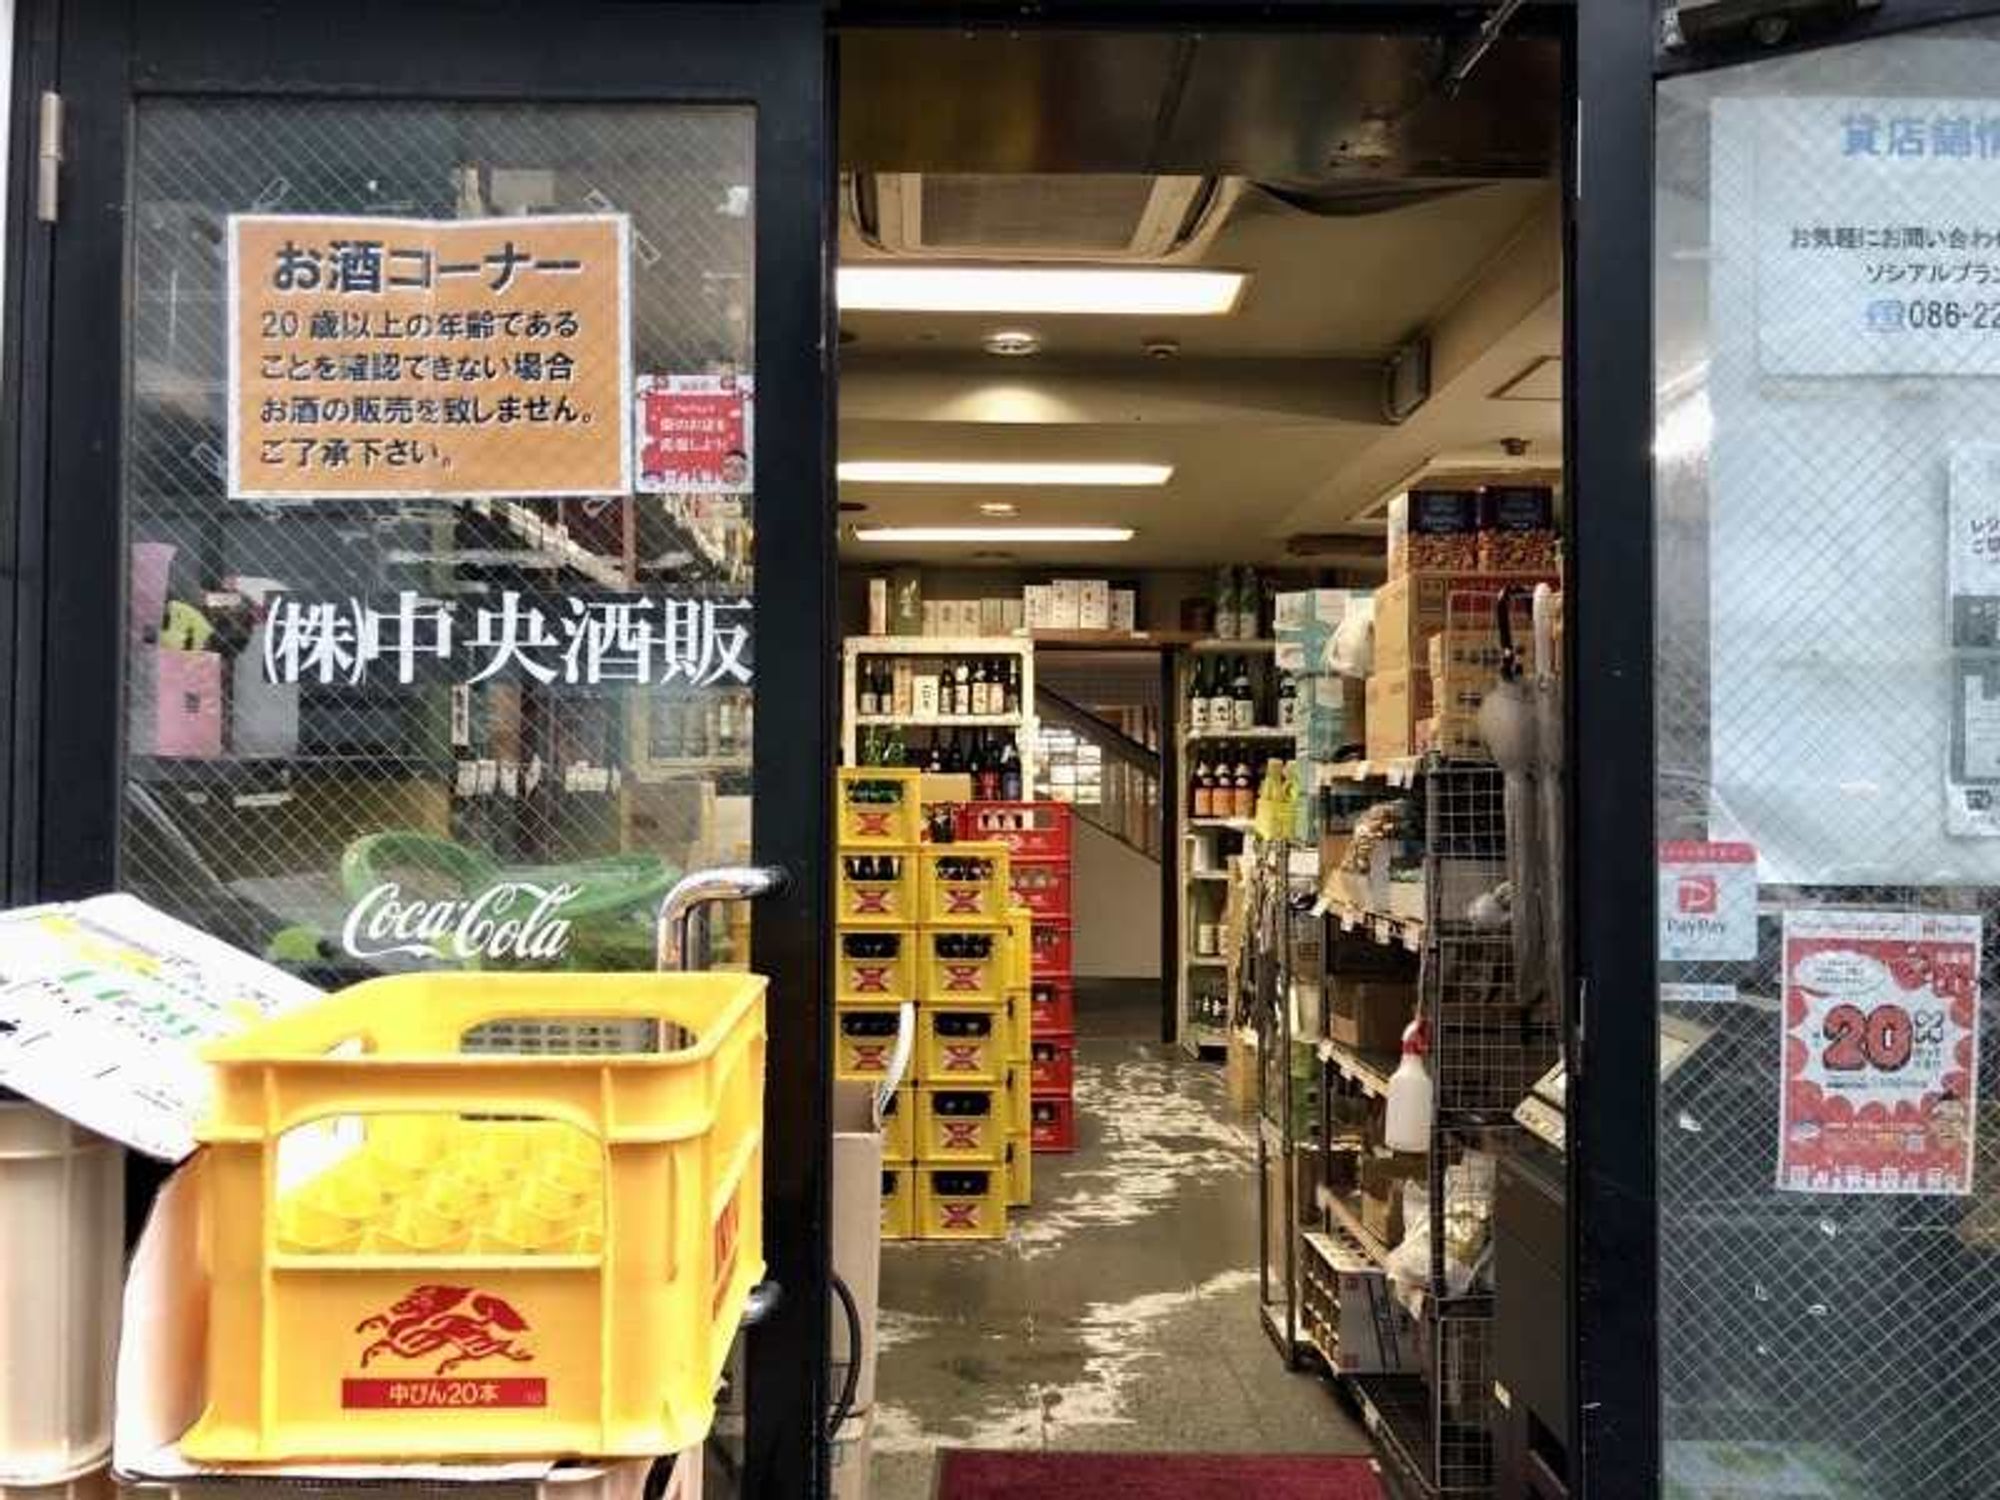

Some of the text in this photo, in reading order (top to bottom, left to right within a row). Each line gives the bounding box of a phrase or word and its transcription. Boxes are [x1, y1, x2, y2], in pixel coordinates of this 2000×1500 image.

[273, 241, 581, 292] お酒コーナー
[261, 352, 574, 382] ことを確認できない場合
[260, 395, 591, 424] お酒の販売を致しません。
[260, 438, 450, 467] ご了承下さい。
[1667, 919, 1726, 936] PayPay
[389, 1382, 501, 1405] 中びん20本
